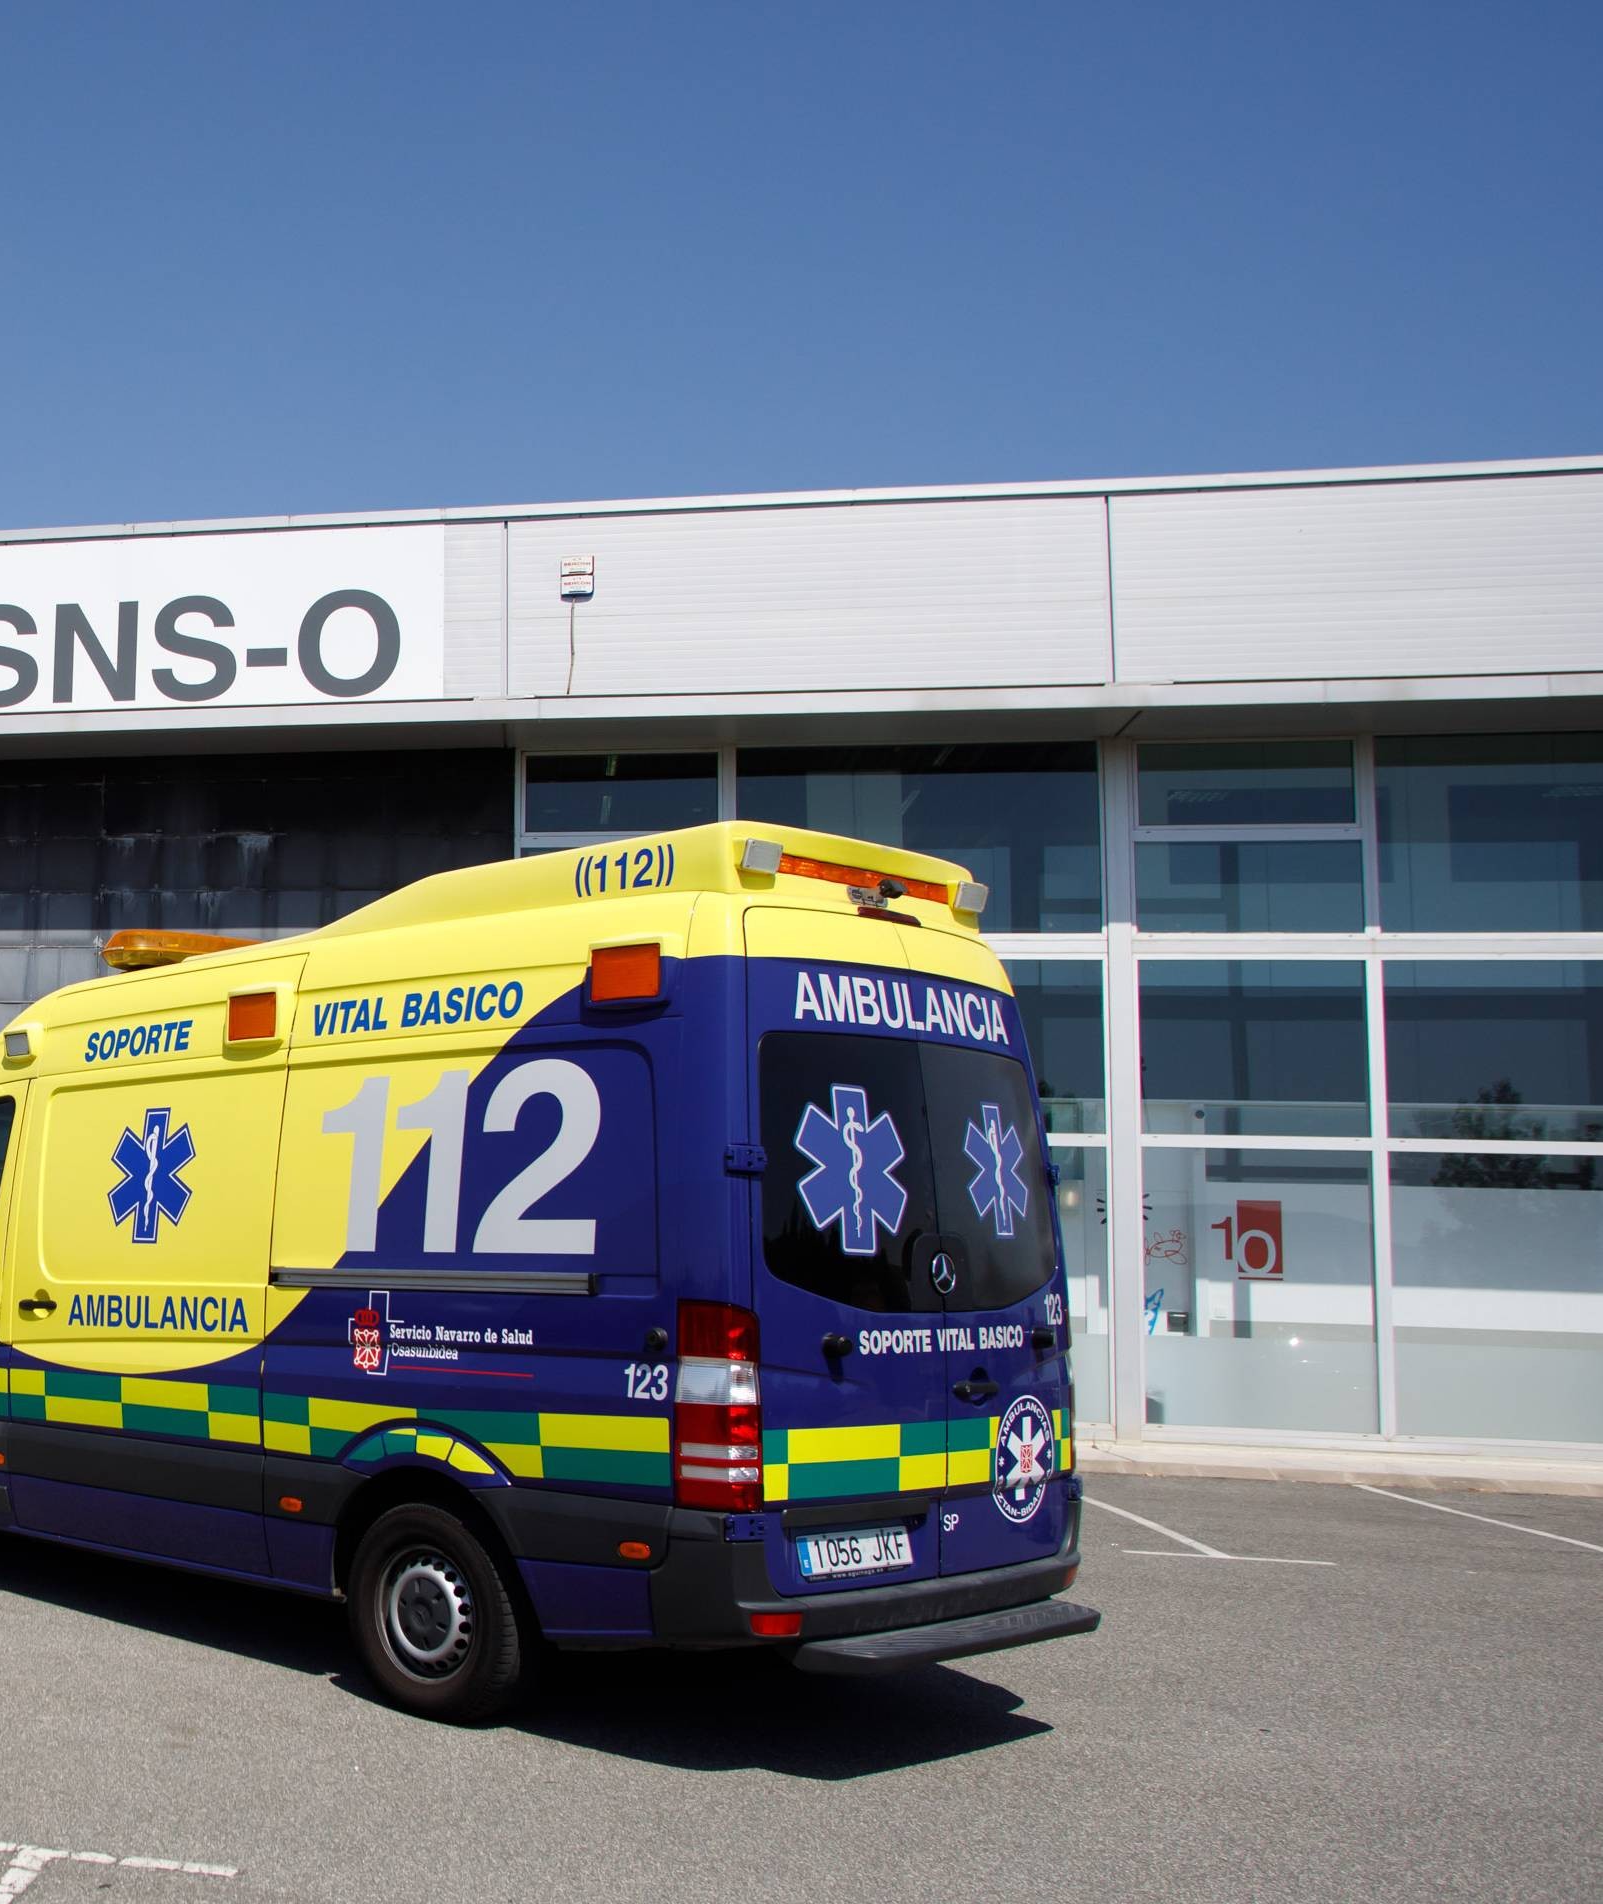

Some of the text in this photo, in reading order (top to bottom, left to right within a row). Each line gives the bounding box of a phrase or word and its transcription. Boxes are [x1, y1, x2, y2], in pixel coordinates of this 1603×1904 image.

[84, 981, 523, 1062] SOPORTE VITAL BASICO
[795, 971, 1009, 1045] AMBULANCIA
[322, 1058, 601, 1254] 112
[1211, 1216, 1276, 1273] 10
[69, 1295, 248, 1333] AMBULANCIA
[1044, 1294, 1063, 1325] 123
[390, 1324, 534, 1346] Servicio Navarro de Salud
[391, 1342, 459, 1360] Osasunbidea
[859, 1325, 1024, 1355] SOPORTE VITAL BASICO
[624, 1363, 668, 1401] 123
[1000, 1401, 1051, 1447] AMBULANCIAS
[943, 1513, 959, 1531] SP
[814, 1530, 904, 1569] 1056 JKF
